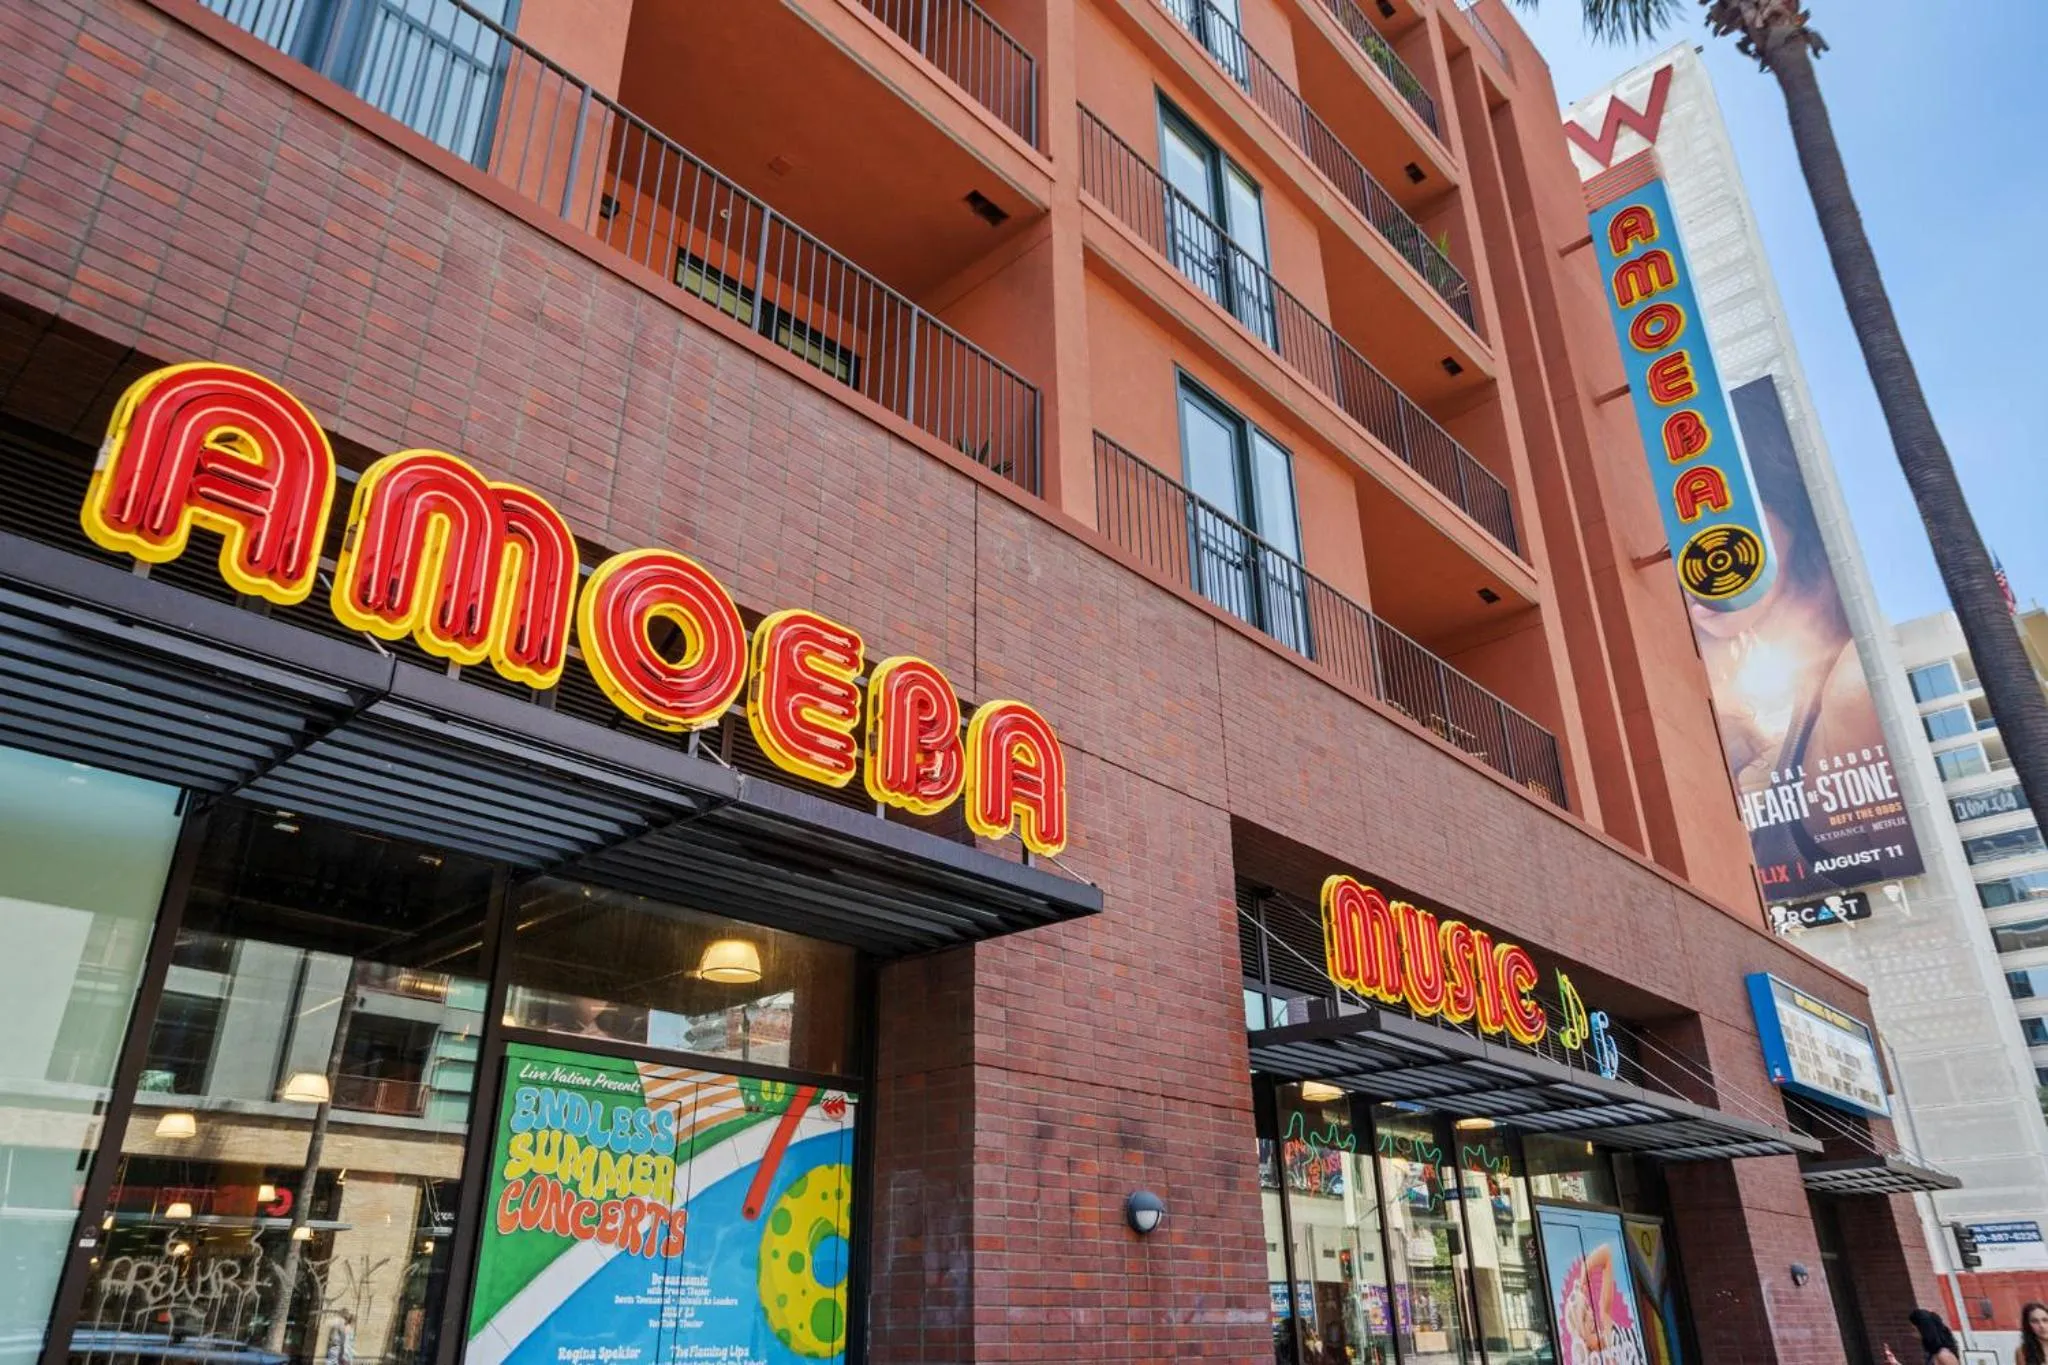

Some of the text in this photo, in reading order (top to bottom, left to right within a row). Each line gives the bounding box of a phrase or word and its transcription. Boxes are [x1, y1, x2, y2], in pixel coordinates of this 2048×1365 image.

[1607, 203, 1732, 523] AMOEBA
[79, 361, 1068, 858] AMOEBA
[1770, 745, 1885, 783] GAL GADOT
[1739, 761, 1899, 831] HEART OF STONE
[1828, 802, 1903, 826] DEFY THE ODDS
[1814, 816, 1908, 844] SKYDANCE NETFLIX
[1814, 848, 1882, 873] AUGUST
[1885, 844, 1904, 858] 11
[1321, 874, 1547, 1044] MUSIC
[518, 1062, 642, 1093] Live Nation Presents
[510, 1087, 677, 1155] ENDLESS
[504, 1130, 677, 1203] SUMMER
[497, 1174, 688, 1259] CONCERTS
[557, 1345, 641, 1364] Regina Spektor
[689, 1345, 729, 1361] Flaming
[730, 1345, 749, 1362] Lips
